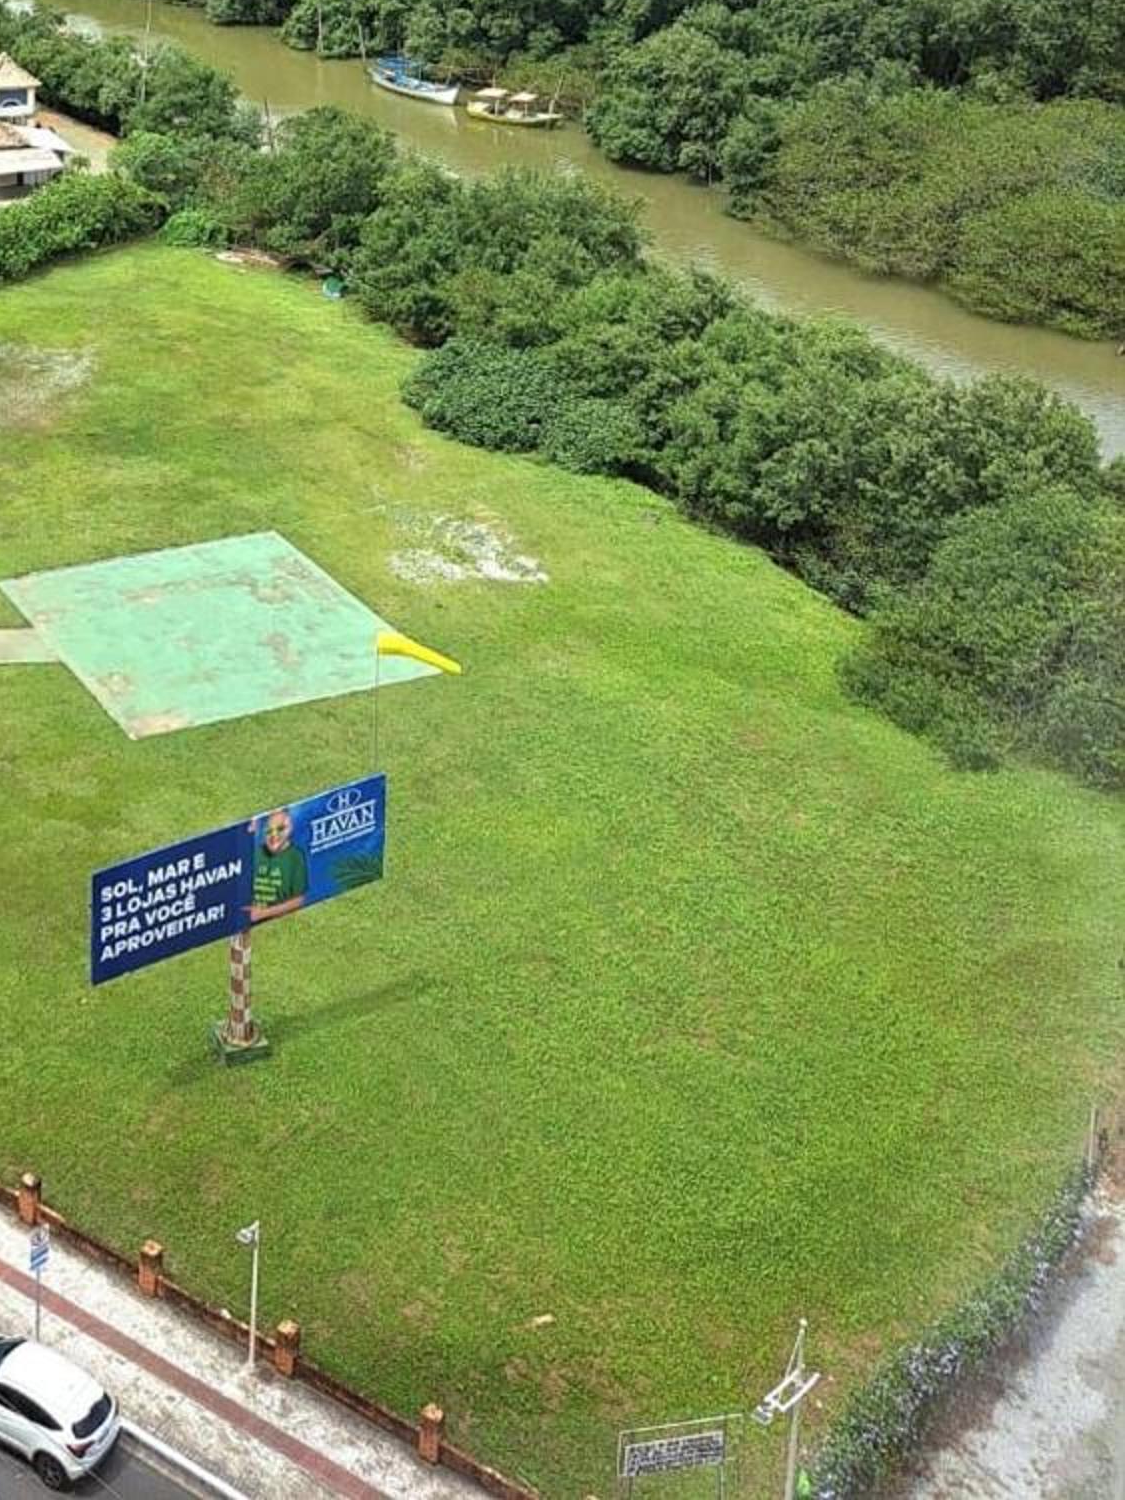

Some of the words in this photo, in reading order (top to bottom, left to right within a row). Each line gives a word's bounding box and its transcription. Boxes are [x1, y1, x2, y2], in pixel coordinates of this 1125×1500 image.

[310, 802, 376, 844] HAVAN
[100, 878, 143, 903] SOL,
[147, 857, 191, 887] MAR
[192, 851, 206, 870] E
[100, 905, 113, 923] 3
[116, 882, 178, 918] LOJAS
[180, 857, 243, 895] HAVAN
[99, 903, 226, 963] APROVEITAR!
[100, 916, 142, 943] PRA
[144, 890, 197, 927] VOCÊ
